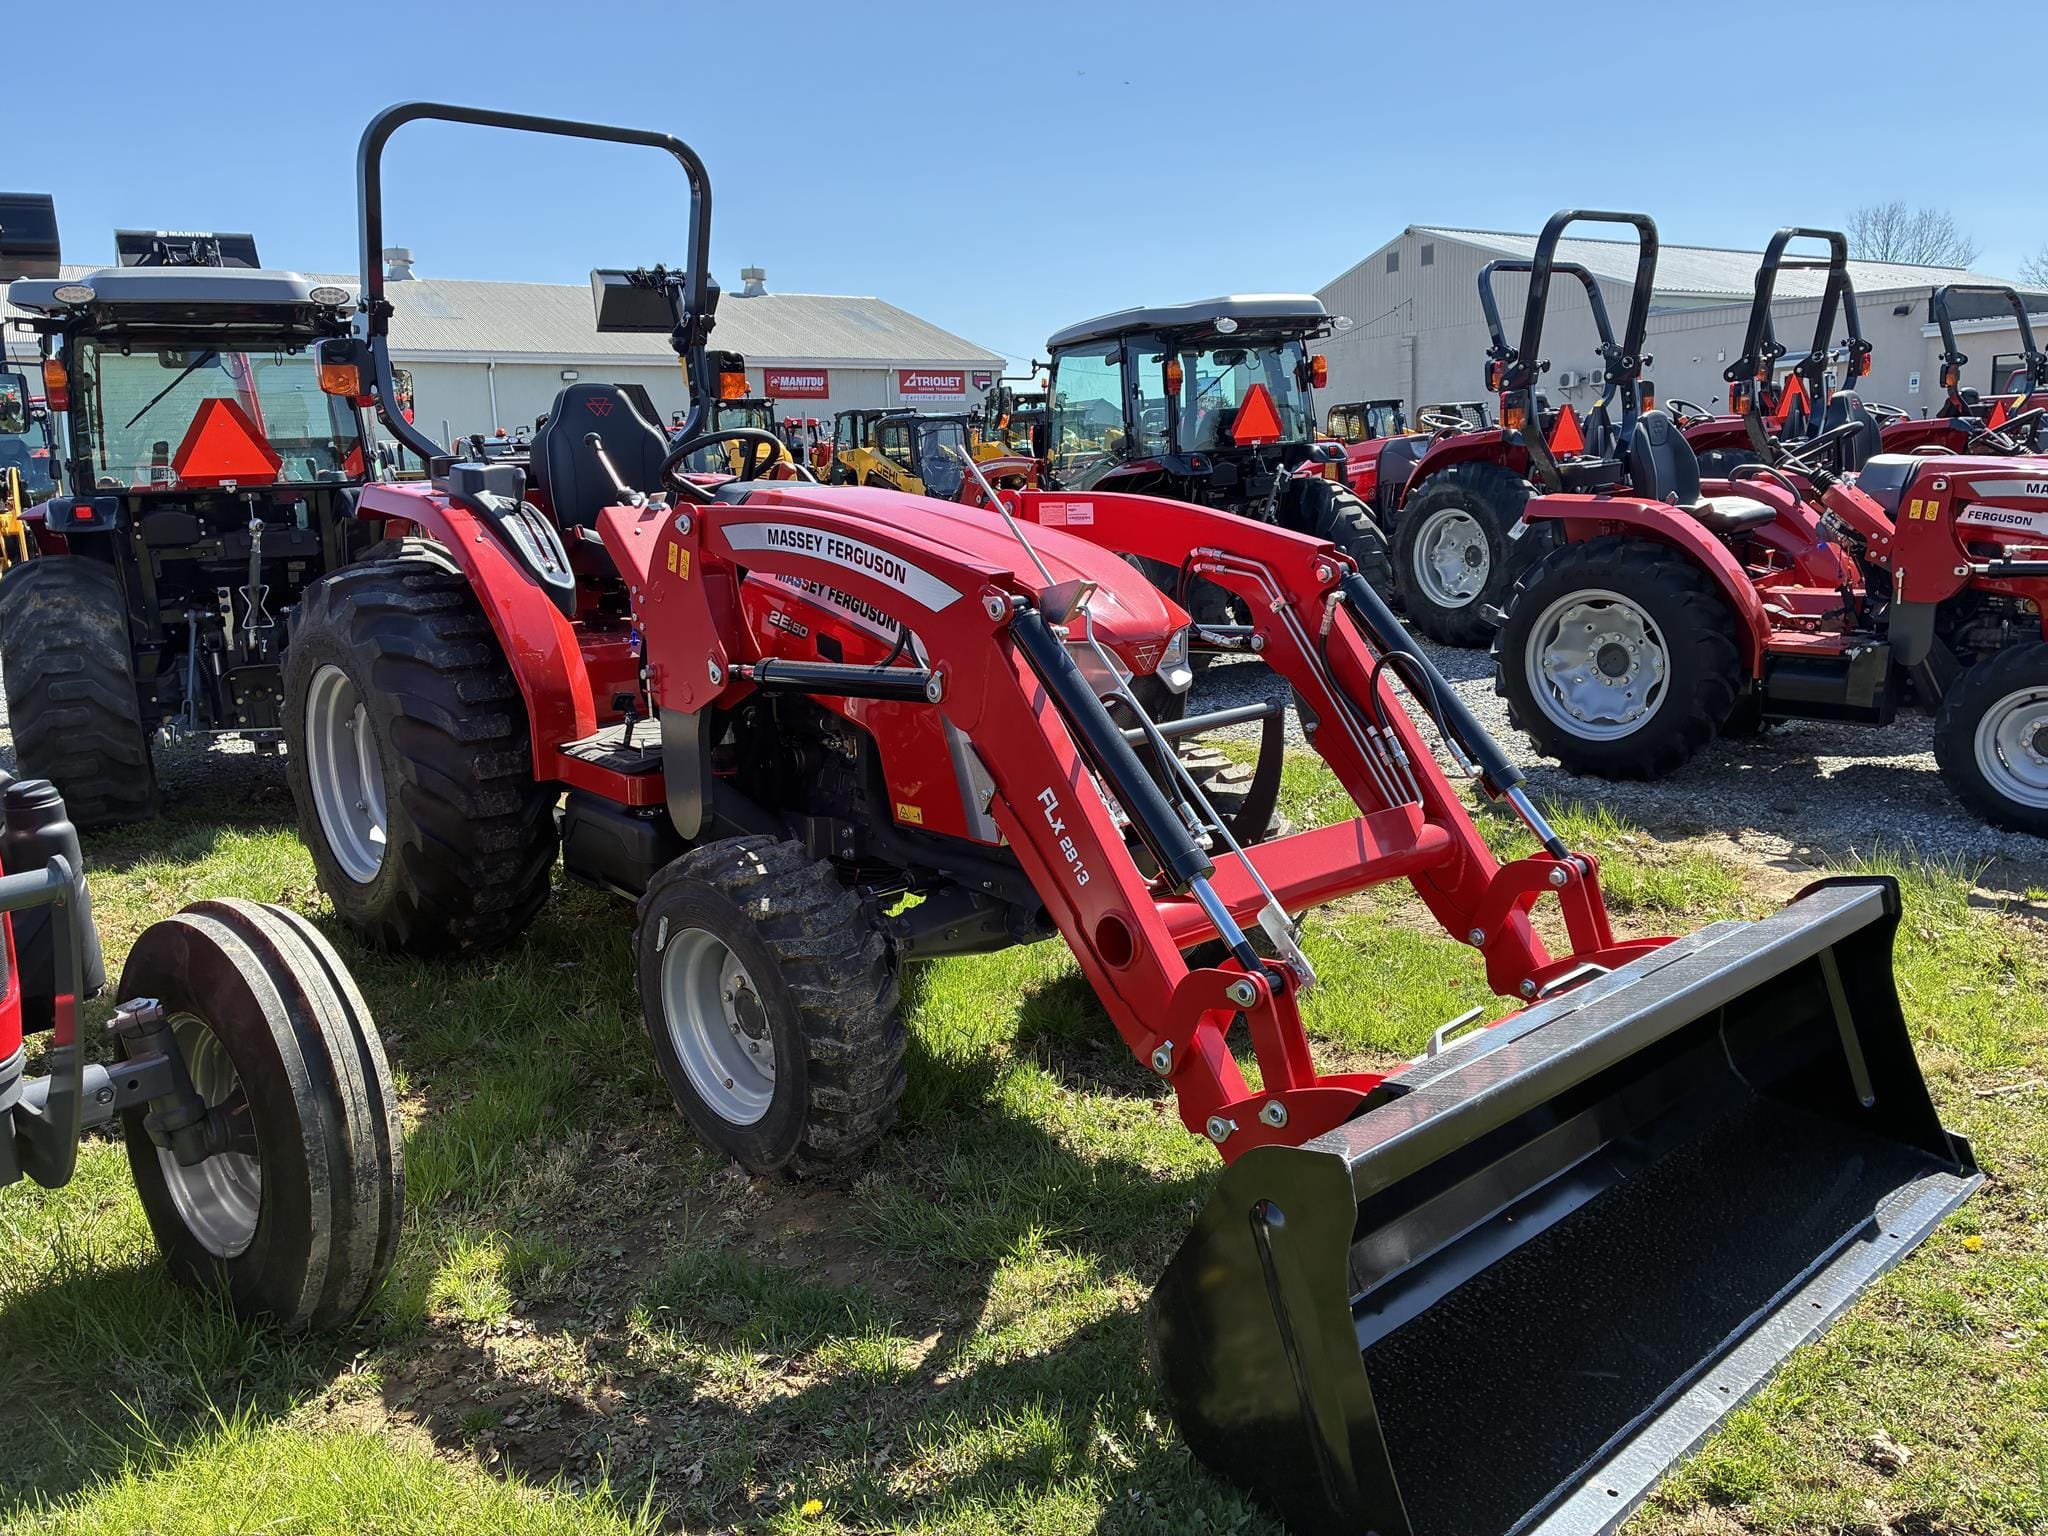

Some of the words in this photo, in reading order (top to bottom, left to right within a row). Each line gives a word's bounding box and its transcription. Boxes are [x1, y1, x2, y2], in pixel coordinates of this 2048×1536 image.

[780, 376, 824, 387] MANITOU
[877, 462, 902, 487] GEHL
[1967, 510, 2033, 526] FERGUSON
[767, 528, 823, 552] MASSEY
[827, 538, 907, 585] FERGUSON
[827, 587, 898, 633] FERGUSON
[1059, 835, 1090, 886] 2813
